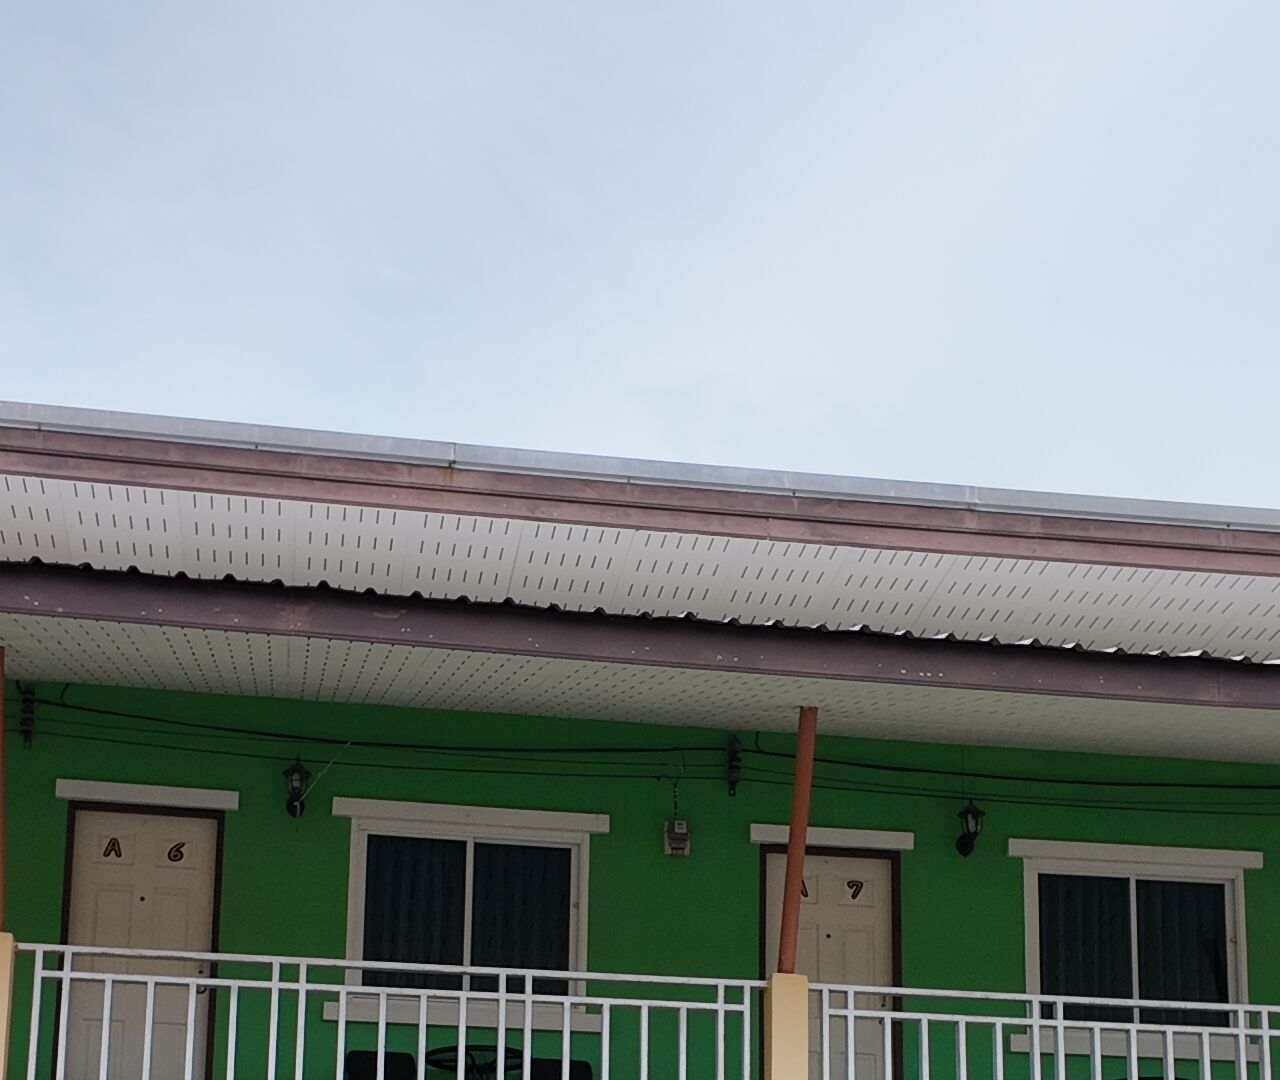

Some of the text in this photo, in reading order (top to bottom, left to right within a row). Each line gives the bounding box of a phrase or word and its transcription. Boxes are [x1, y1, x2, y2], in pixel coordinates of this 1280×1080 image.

[102, 837, 186, 862] A 6
[847, 880, 864, 900] 7
